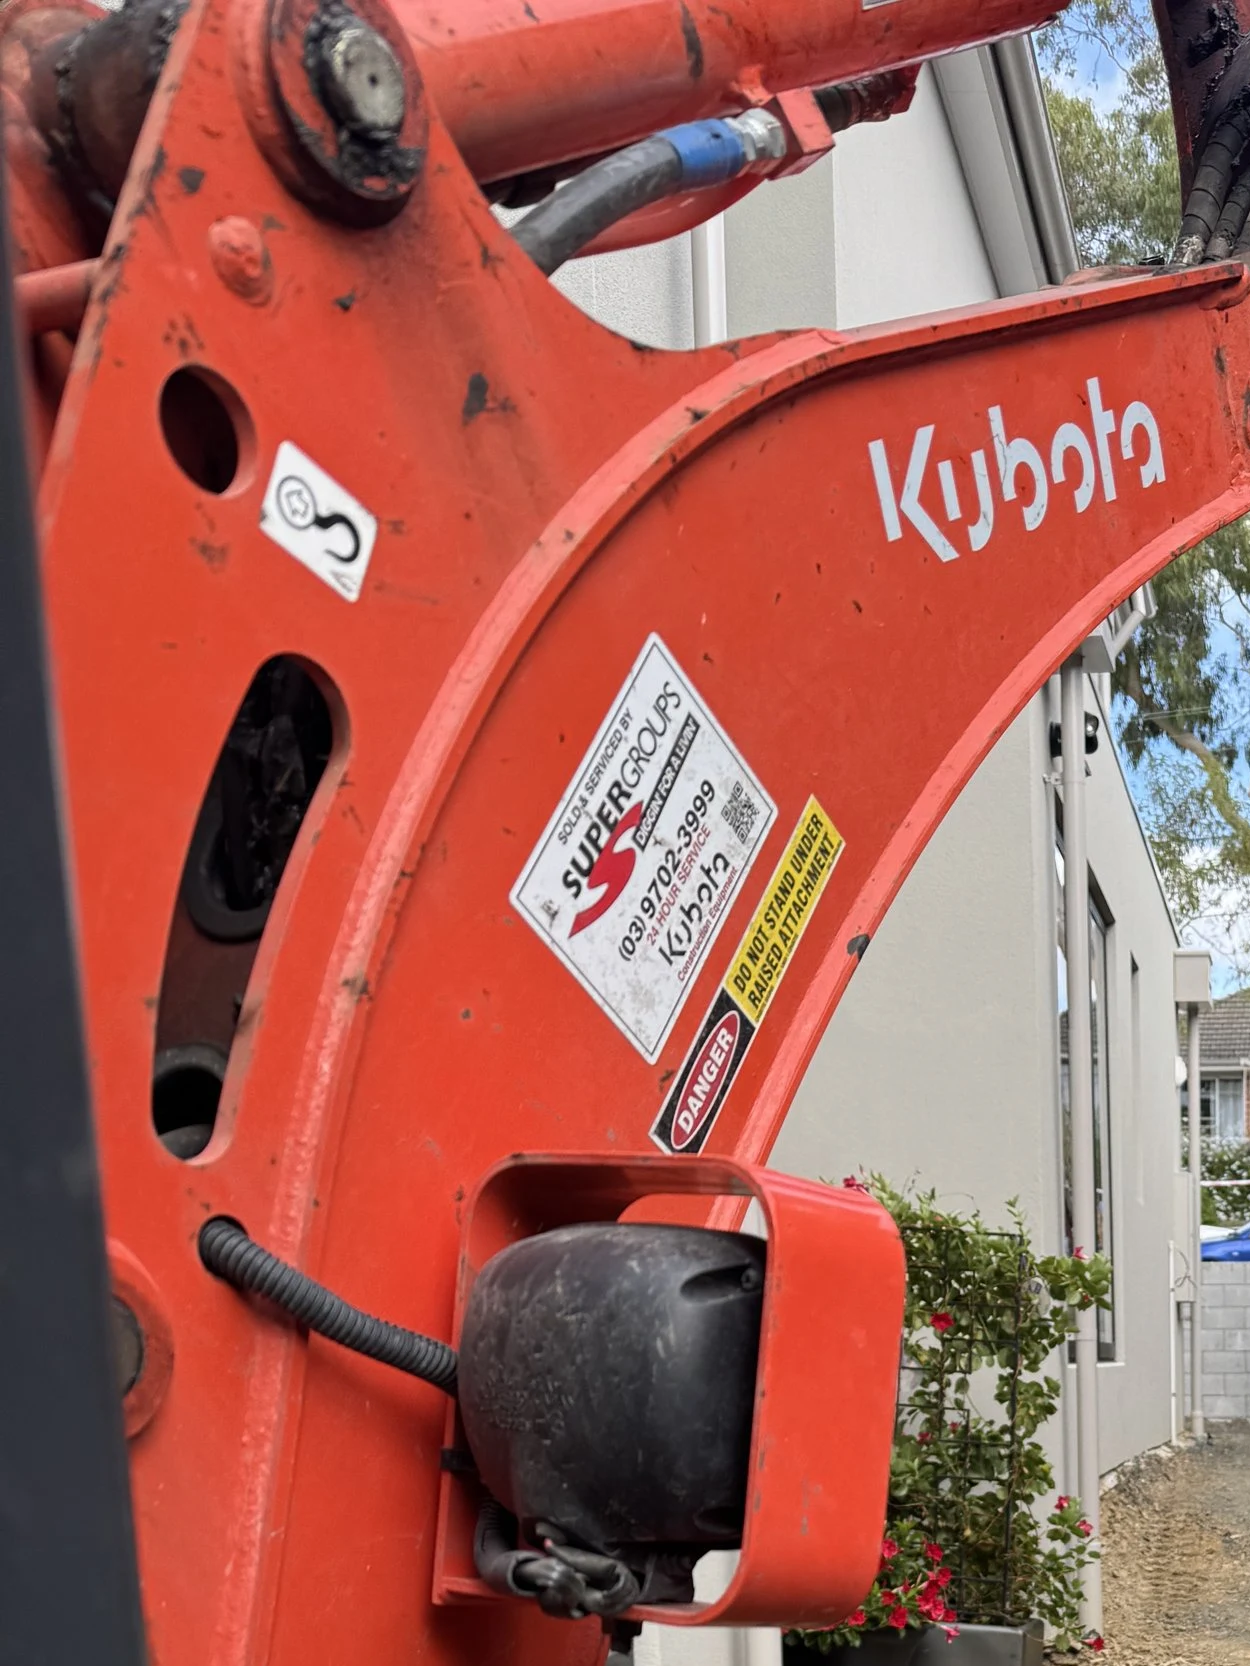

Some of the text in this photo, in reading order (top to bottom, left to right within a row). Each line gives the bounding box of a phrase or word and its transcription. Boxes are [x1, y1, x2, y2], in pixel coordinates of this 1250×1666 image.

[868, 376, 1166, 563] Kubota
[558, 804, 583, 845] SOLD
[584, 728, 623, 796] SERVICED
[620, 707, 634, 733] BY
[562, 680, 682, 900] SUPERGROUPS
[657, 766, 676, 796] FOR
[618, 779, 715, 962] (03) 9702-3999
[646, 823, 712, 946] 24 HOUR SERVICE
[658, 851, 730, 967] Kubota
[677, 866, 738, 982] Construction Equipment
[733, 962, 752, 995] DO
[746, 927, 770, 969] NOT
[764, 869, 796, 929] STAND
[789, 813, 825, 875] UNDER
[747, 943, 784, 1010] RAISED
[779, 831, 836, 949] ATTACHMENT
[677, 1027, 735, 1135] DANGER
